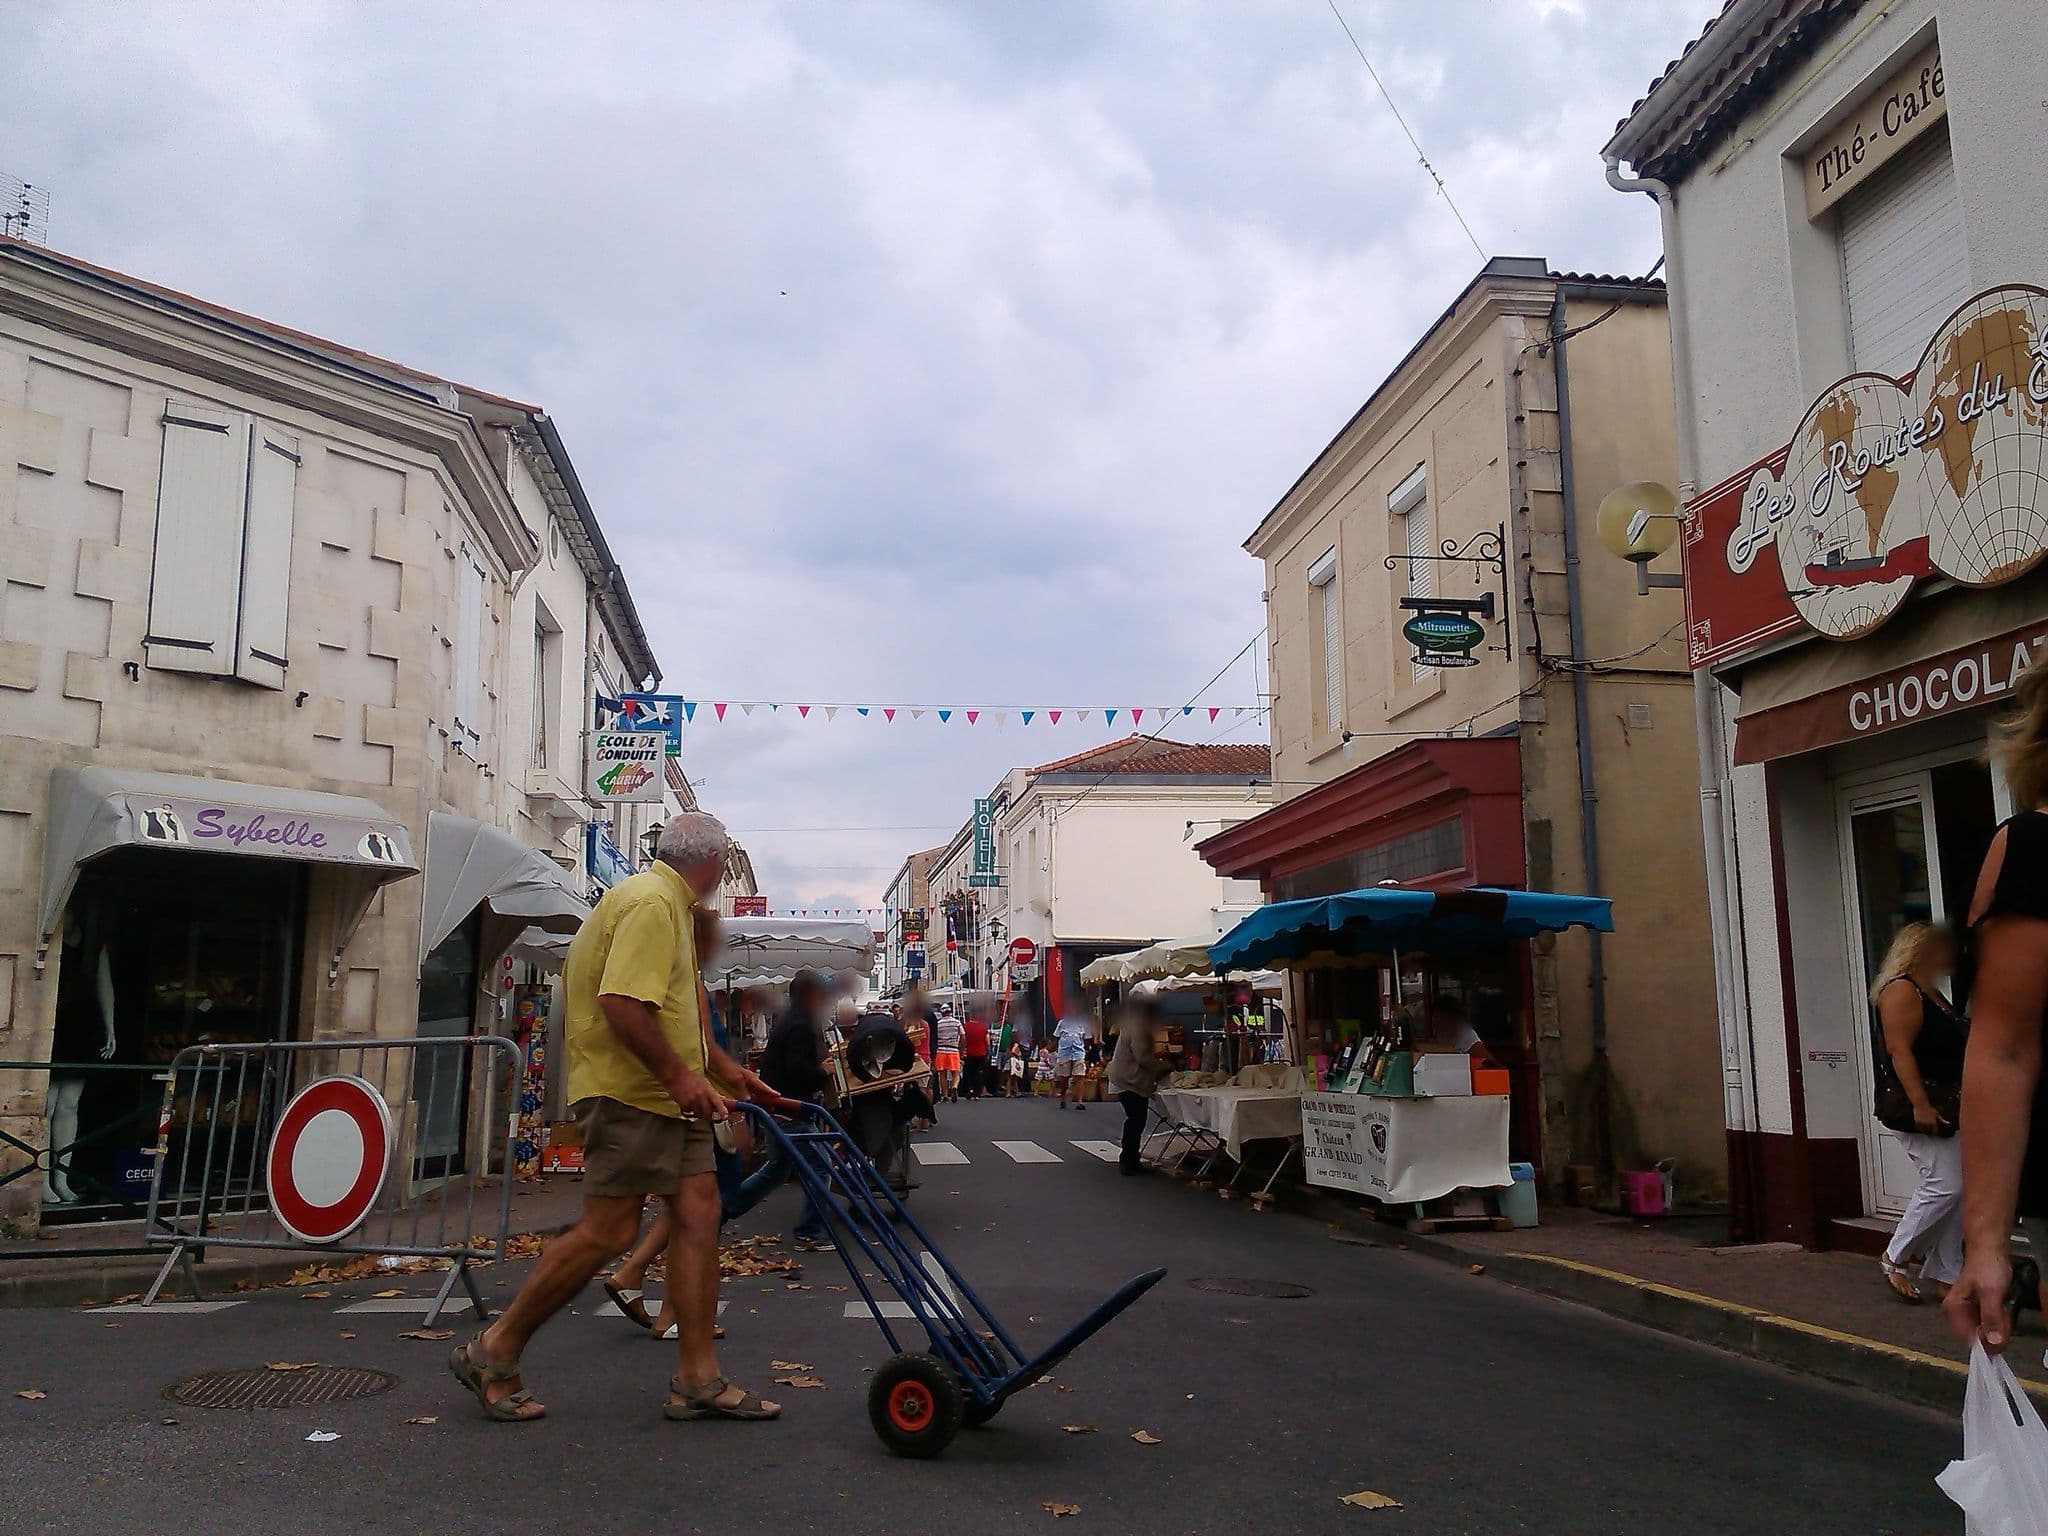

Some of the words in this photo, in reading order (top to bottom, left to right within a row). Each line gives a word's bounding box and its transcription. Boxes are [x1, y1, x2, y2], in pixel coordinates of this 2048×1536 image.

[1815, 55, 1946, 193] Thé-Café
[1735, 482, 1796, 565] Les
[1810, 404, 1945, 517] Routes
[1958, 361, 2009, 424] du
[1417, 622, 1470, 632] Mitronette
[1416, 655, 1440, 665] Artisan
[1441, 656, 1475, 667] Boulanger
[597, 735, 636, 748] ECOLE
[638, 735, 656, 748] DE
[596, 748, 658, 761] CONDUITE
[193, 808, 327, 848] Sybelle
[978, 800, 990, 864] HOTEL
[1304, 1145, 1335, 1160] GRAND
